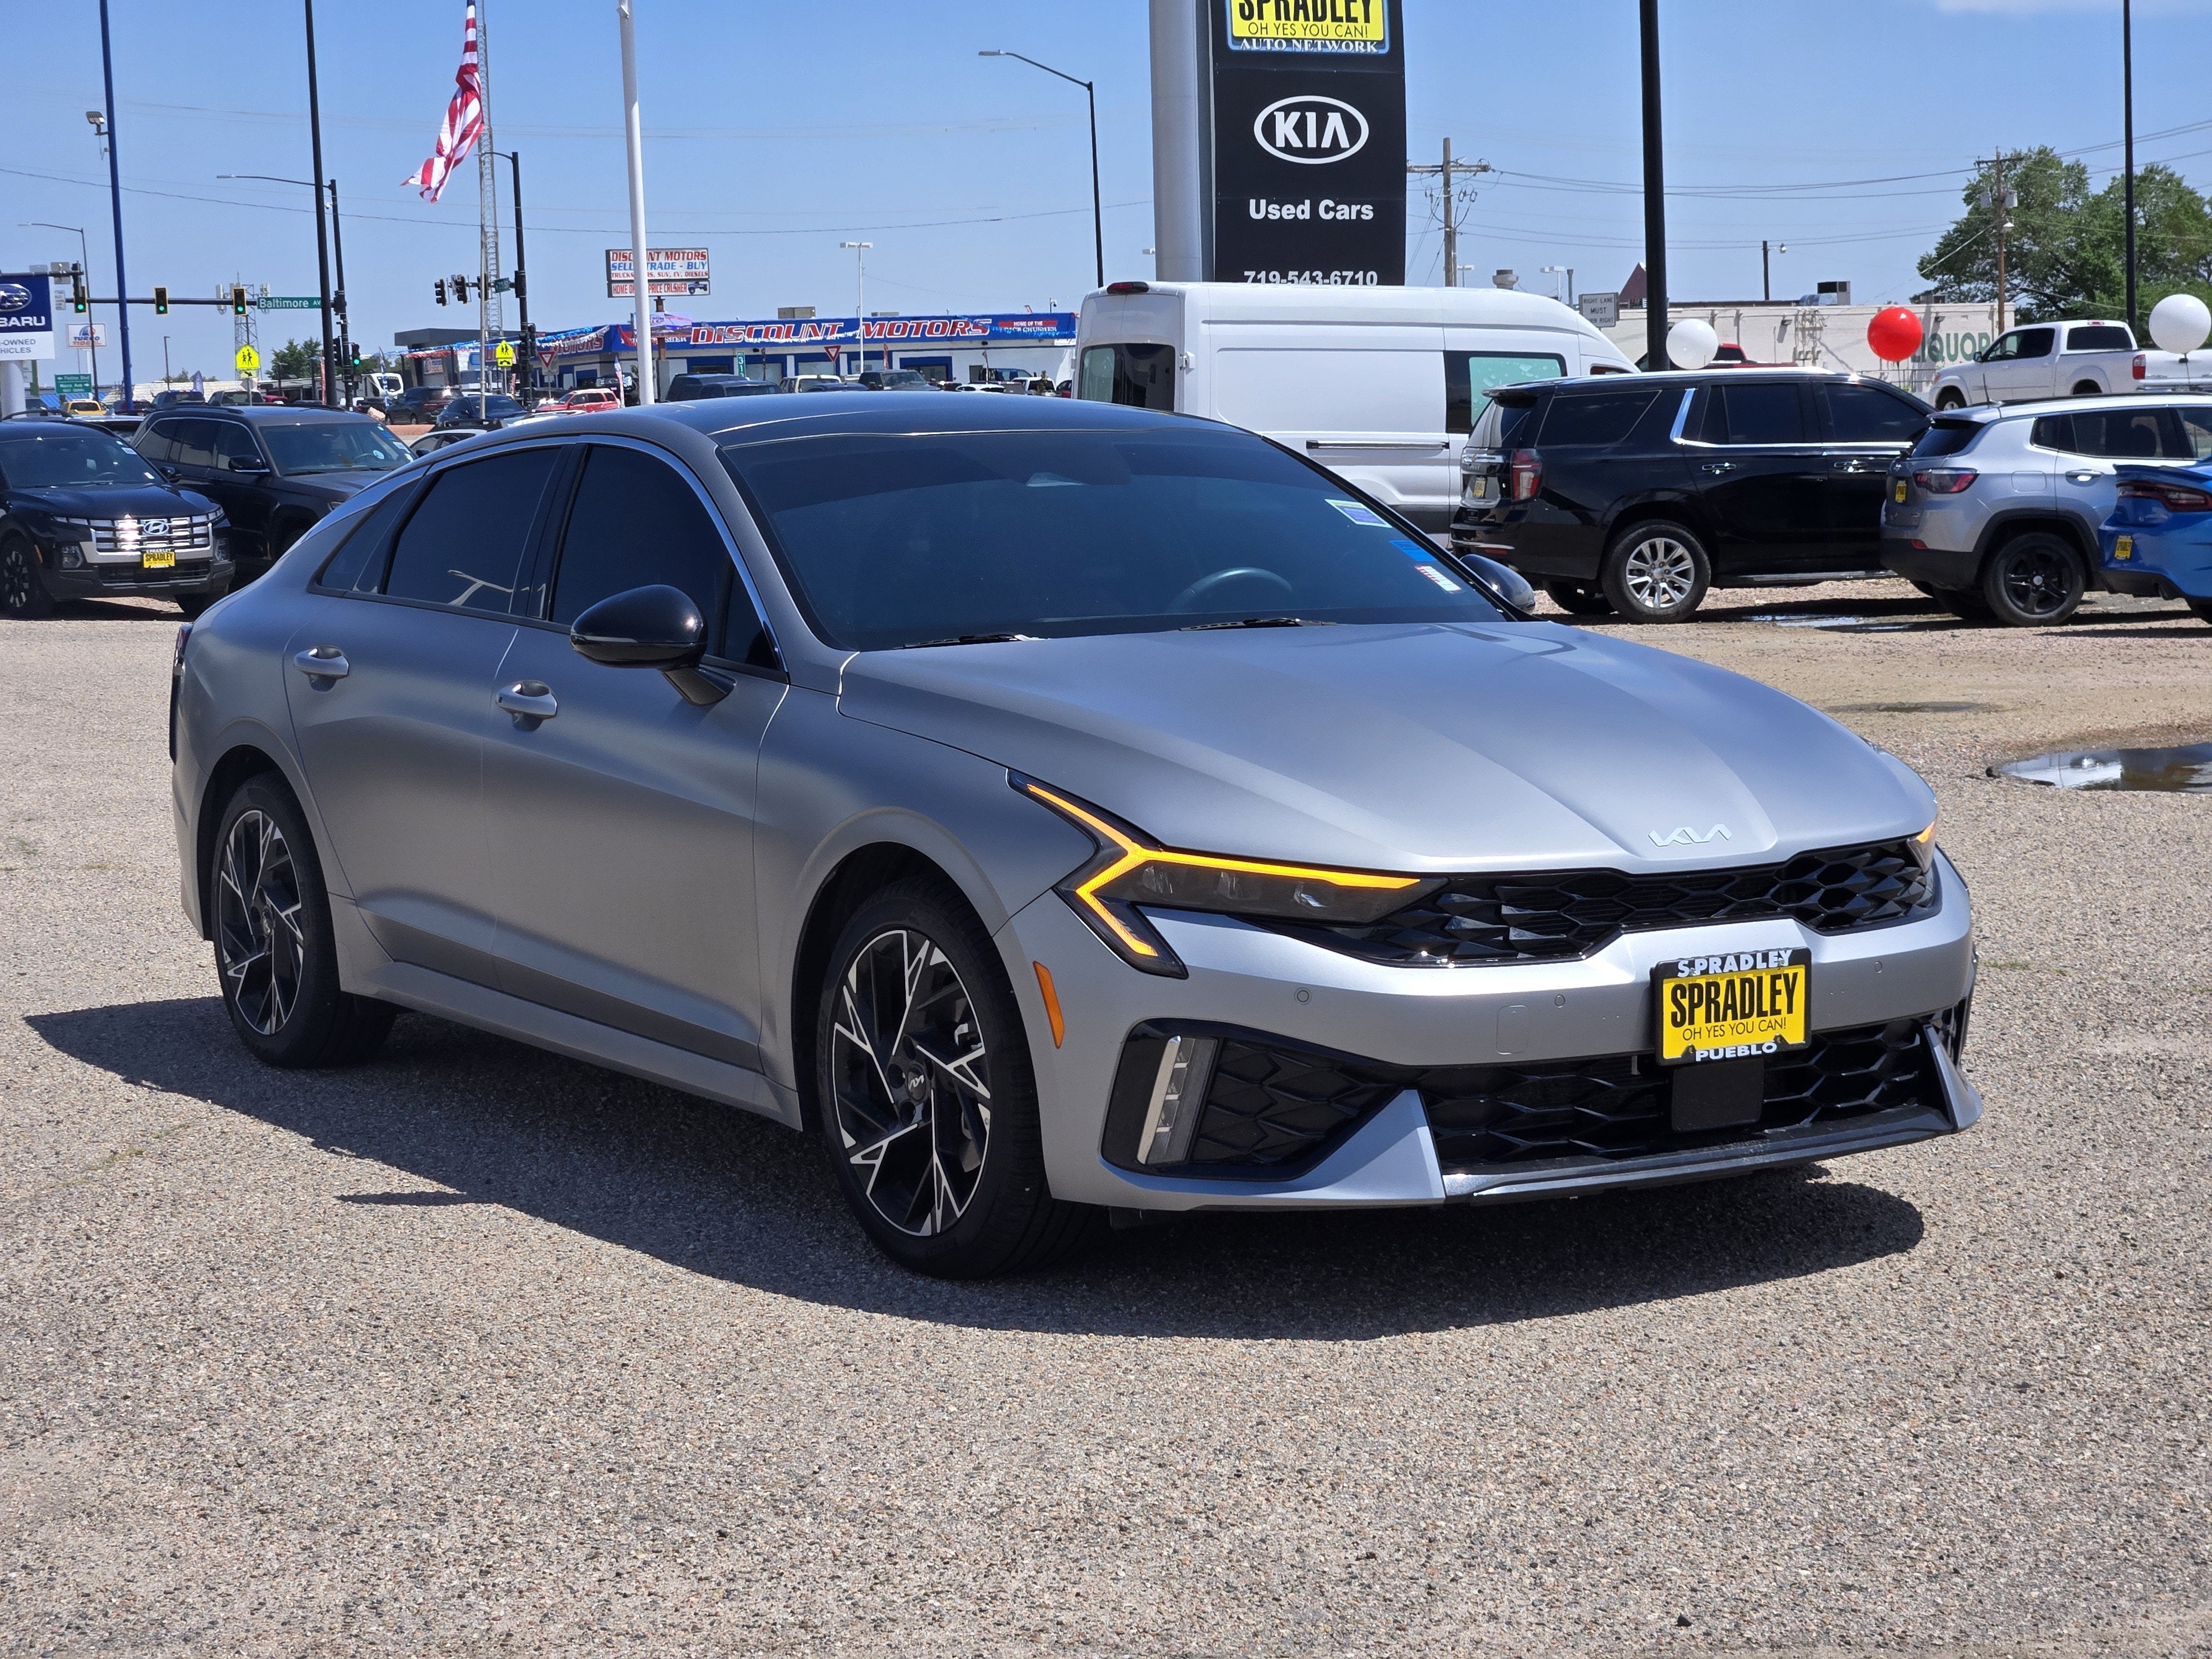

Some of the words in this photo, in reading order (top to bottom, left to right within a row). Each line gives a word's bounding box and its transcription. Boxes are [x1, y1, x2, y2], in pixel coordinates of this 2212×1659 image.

[1248, 22, 1268, 35] OH
[1274, 23, 1296, 36] YES
[1301, 24, 1328, 37] YOU
[1334, 24, 1368, 38] CAN!
[1239, 38, 1287, 50] AUTO
[1292, 39, 1378, 53] NETWORK
[1274, 111, 1350, 148] KIA
[1249, 199, 1310, 220] Used
[1318, 199, 1374, 220] Cars
[612, 252, 662, 262] DISCNT
[664, 251, 707, 261] MOTORS
[1244, 271, 1378, 286] 719-543-6710
[613, 284, 628, 294] HOME
[648, 283, 662, 294] PRICE
[664, 283, 687, 293] CRUSHER
[259, 298, 309, 308] Baltimore
[0, 316, 46, 327] BARU
[690, 322, 844, 345] DISCOUNT
[855, 319, 993, 339] MOTORS
[145, 553, 173, 562] SPRADLEY
[1677, 949, 1793, 978] SPRADLEY
[1671, 972, 1799, 1029] SPRADLEY
[1682, 1026, 1702, 1041] OH
[1707, 1024, 1725, 1039] YES
[1729, 1021, 1754, 1036] YOU
[1758, 1016, 1786, 1031] CAN!
[1695, 1042, 1777, 1062] PUEBLO
